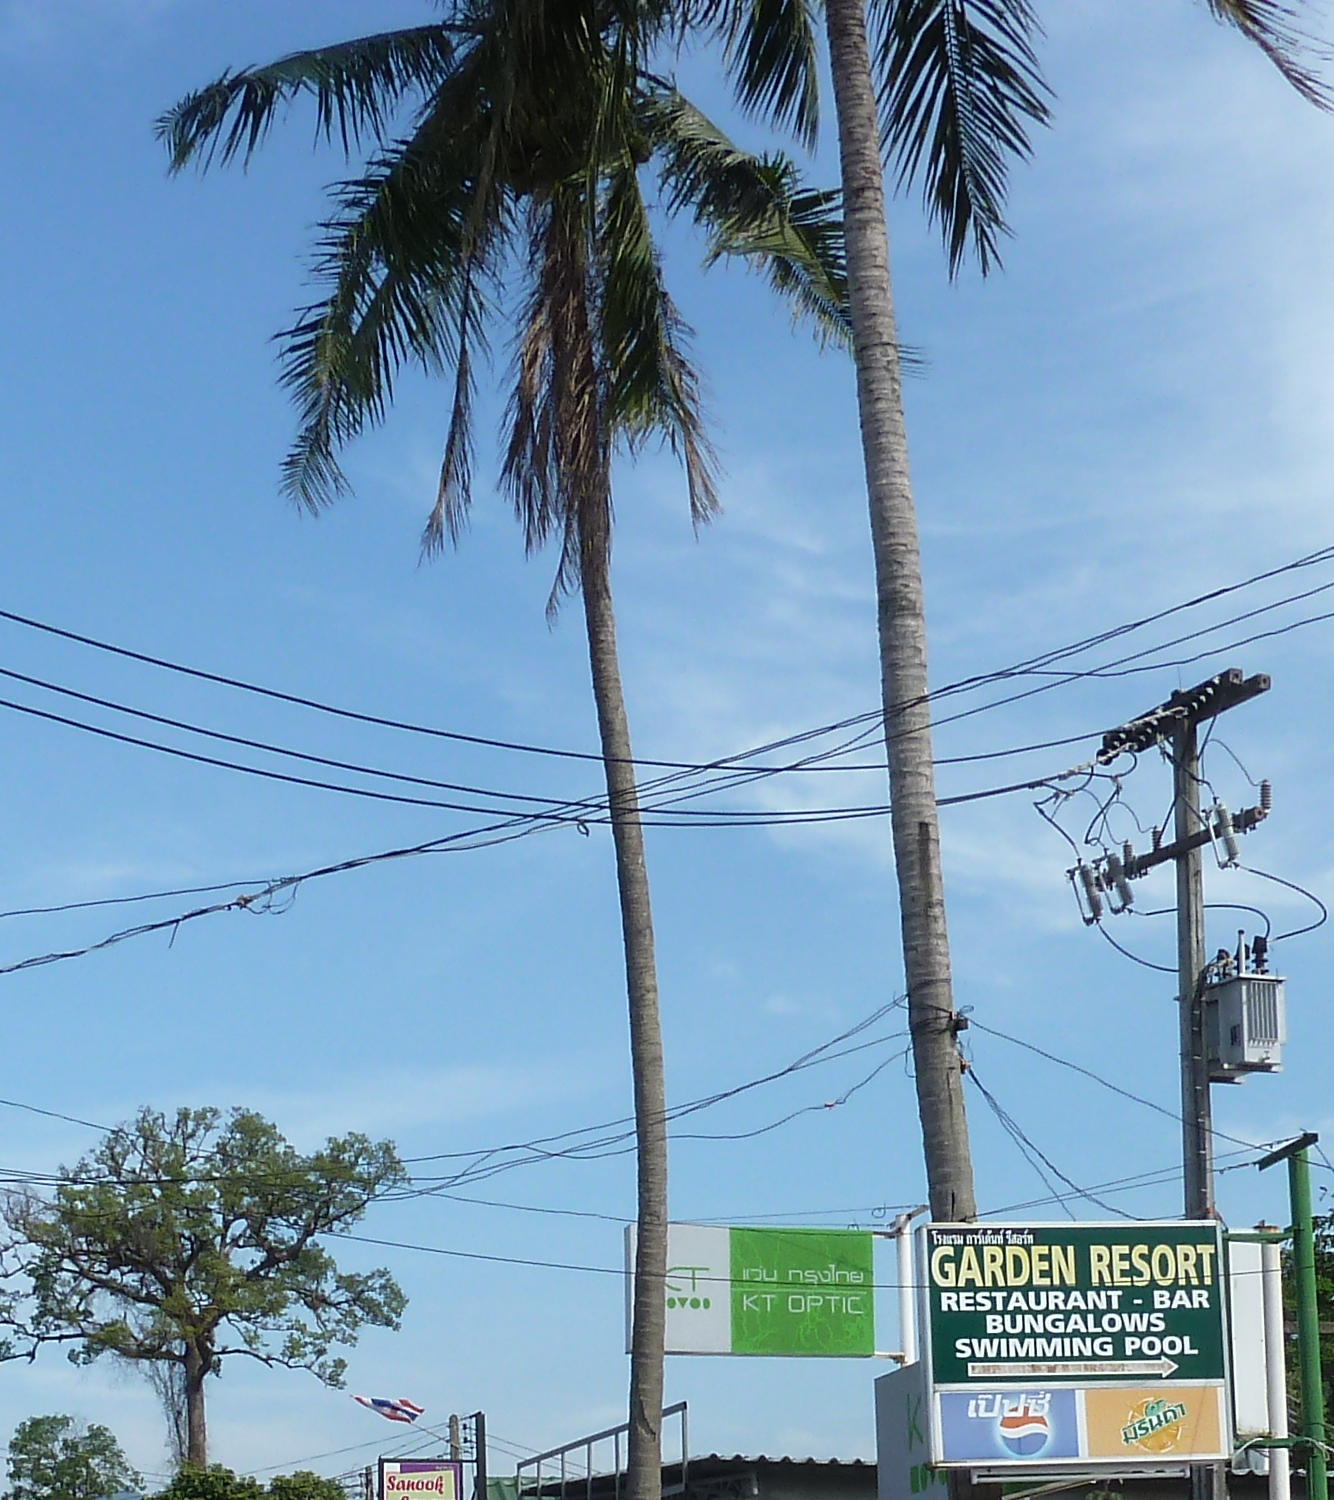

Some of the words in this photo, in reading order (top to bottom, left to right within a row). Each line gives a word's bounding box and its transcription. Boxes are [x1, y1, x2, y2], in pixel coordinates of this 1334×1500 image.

[931, 1245, 1076, 1287] GARDEN
[1090, 1244, 1215, 1286] RESORT
[743, 1294, 777, 1311] KT
[788, 1294, 864, 1314] OPTIC
[940, 1290, 1123, 1311] RESTAURANT
[1153, 1289, 1210, 1309] BAR
[986, 1312, 1165, 1334] BUNGALOWS
[955, 1336, 1113, 1358] SWIMMING
[1124, 1335, 1199, 1356] POOL
[386, 1475, 444, 1494] Sanook
